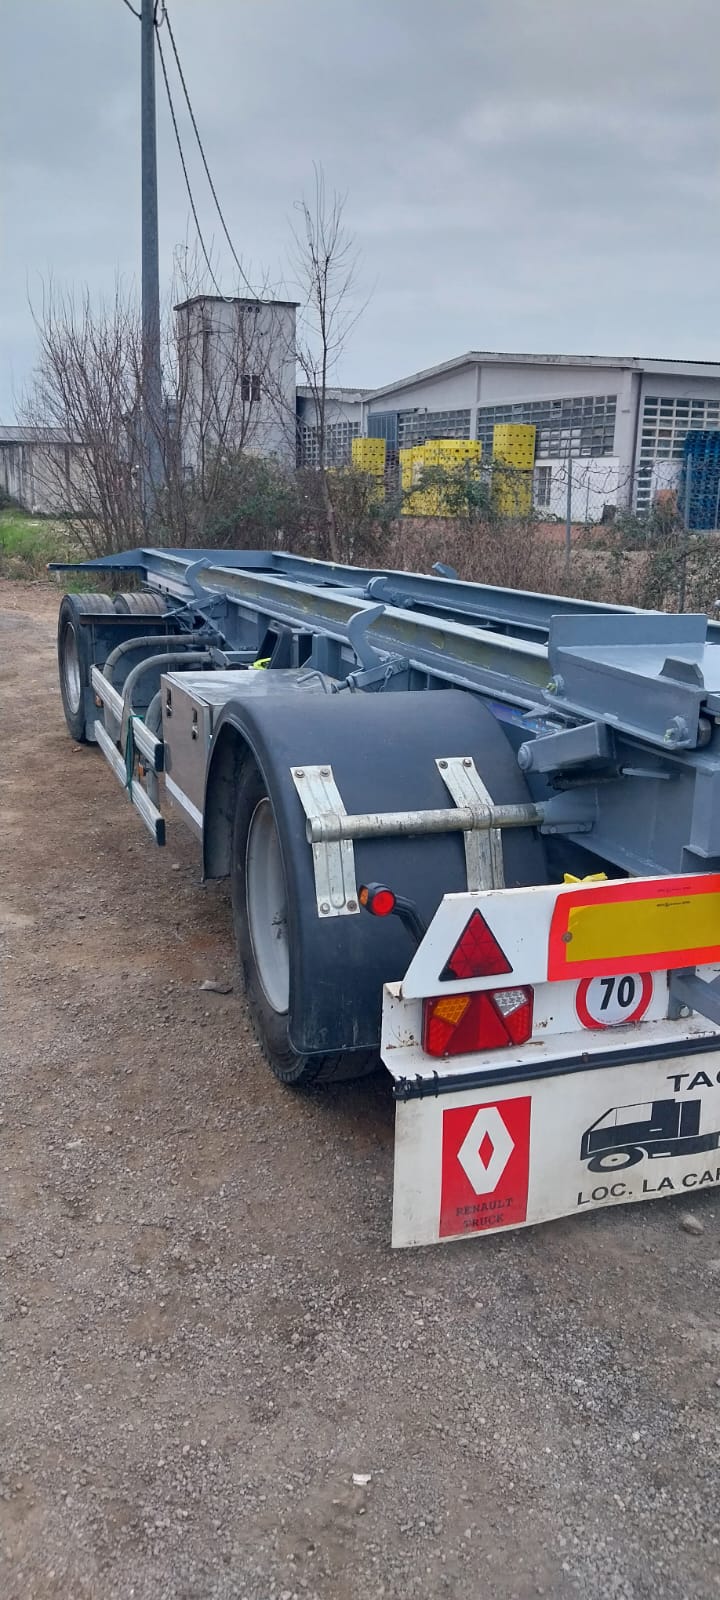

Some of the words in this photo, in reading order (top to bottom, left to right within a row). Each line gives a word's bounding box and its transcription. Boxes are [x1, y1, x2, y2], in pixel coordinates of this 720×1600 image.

[600, 976, 635, 1010] 70
[666, 1071, 720, 1093] TA
[577, 1183, 633, 1206] LOC.
[643, 1177, 675, 1192] LA
[456, 1198, 513, 1216] RENAULT
